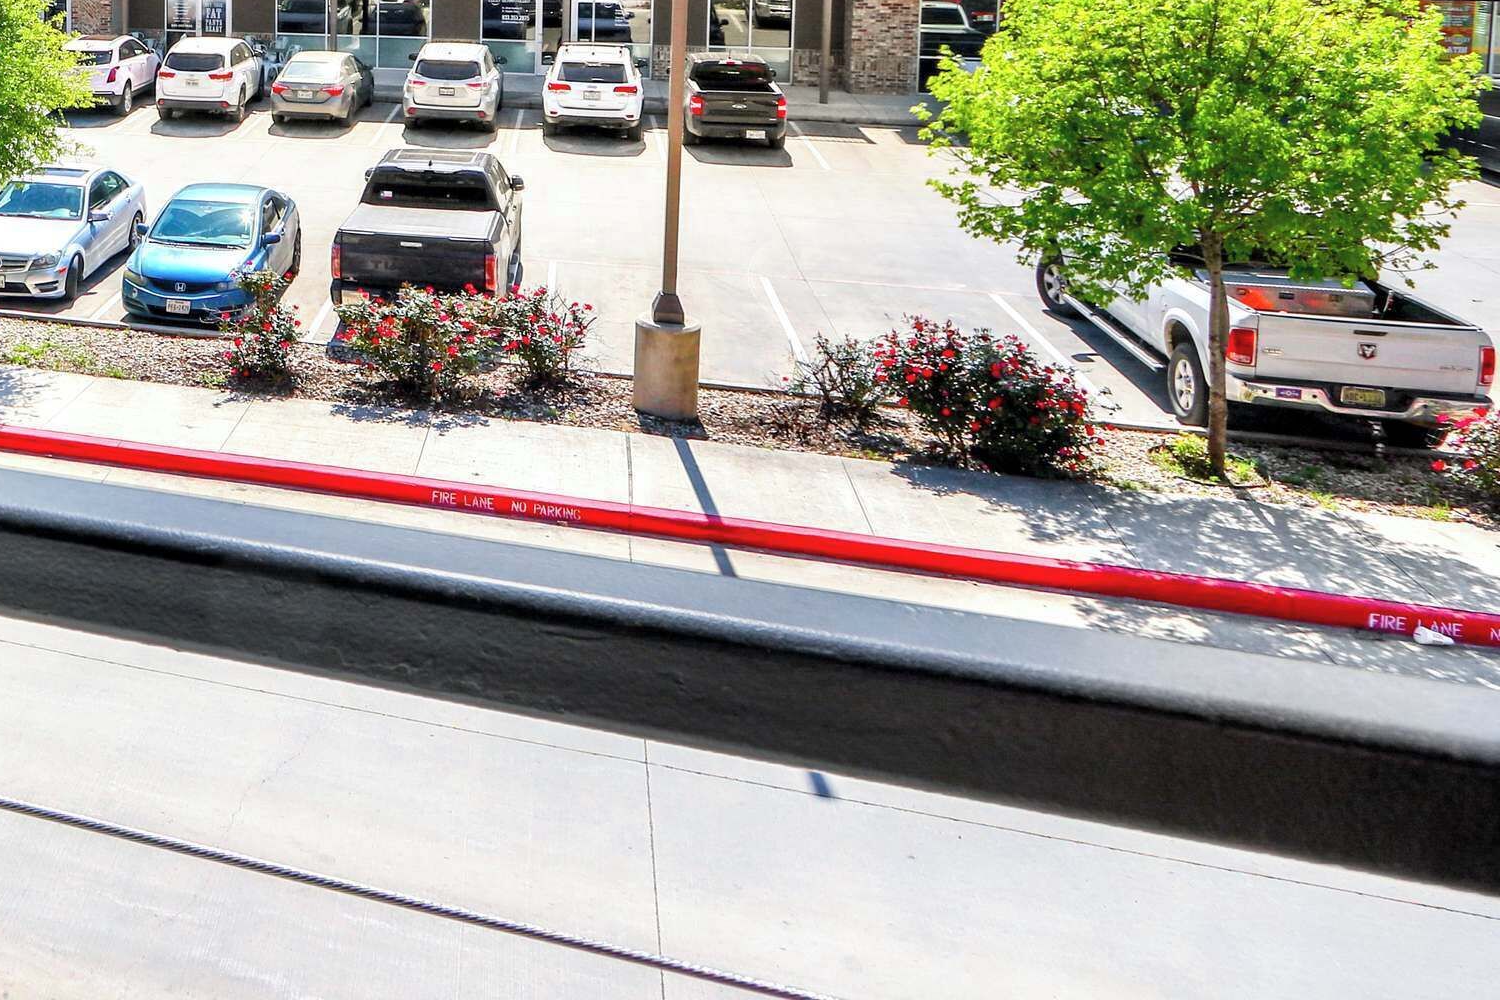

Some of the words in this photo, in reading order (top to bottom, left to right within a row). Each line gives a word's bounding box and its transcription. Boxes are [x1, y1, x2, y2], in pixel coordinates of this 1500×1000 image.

[432, 490, 457, 505] FIRE
[464, 495, 495, 511] LANE
[511, 502, 527, 513] NO
[533, 503, 582, 521] PARKING
[1368, 613, 1407, 631] FIRE
